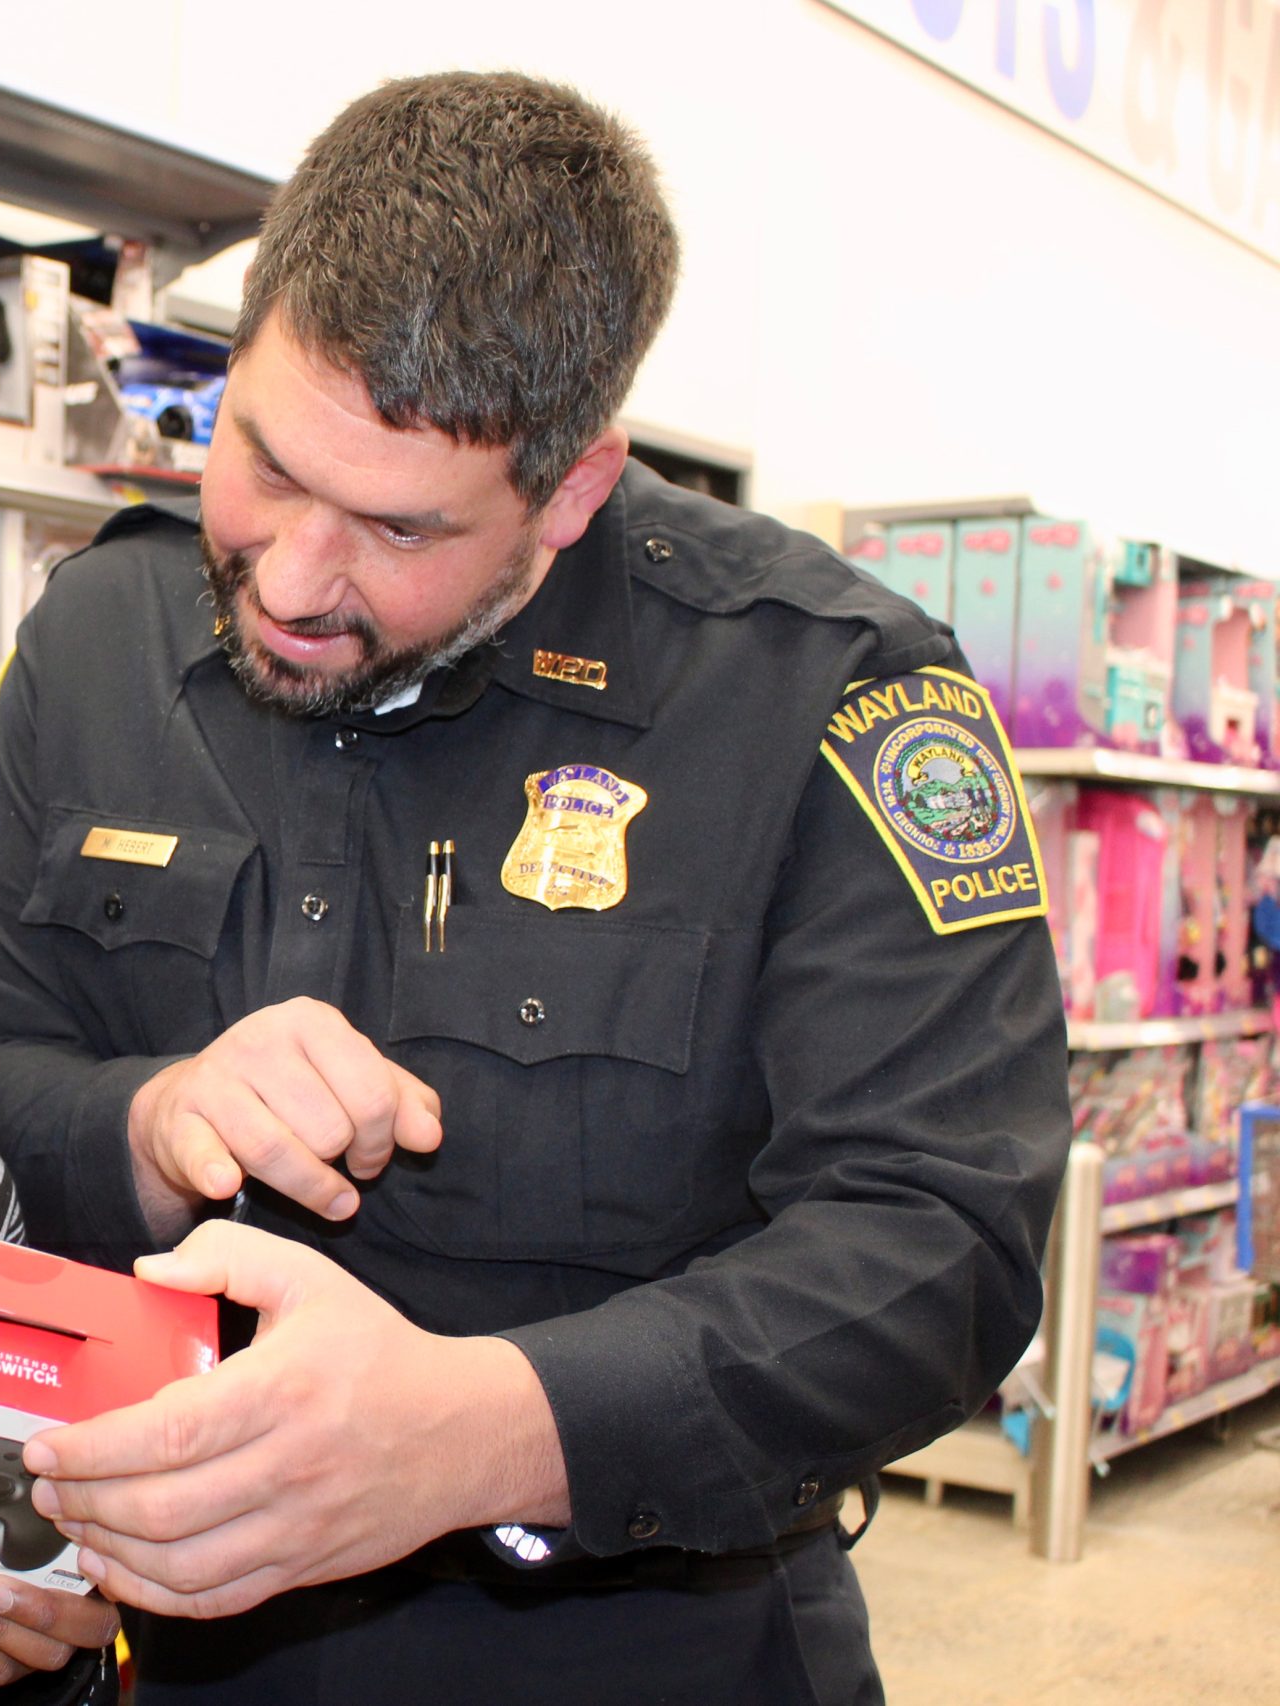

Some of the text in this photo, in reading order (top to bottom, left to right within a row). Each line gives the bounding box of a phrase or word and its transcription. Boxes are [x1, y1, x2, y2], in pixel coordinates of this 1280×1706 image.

[826, 679, 983, 744] WAYLAND
[884, 722, 976, 764] INCORPORATED
[913, 747, 965, 769] WAYLAND
[546, 767, 629, 804] WAYLAND
[546, 795, 615, 819] POLICE
[893, 811, 941, 852] FOUNDED
[958, 838, 993, 858] 1835
[519, 862, 609, 886] DETECTIVE
[930, 862, 1038, 908] POLICE
